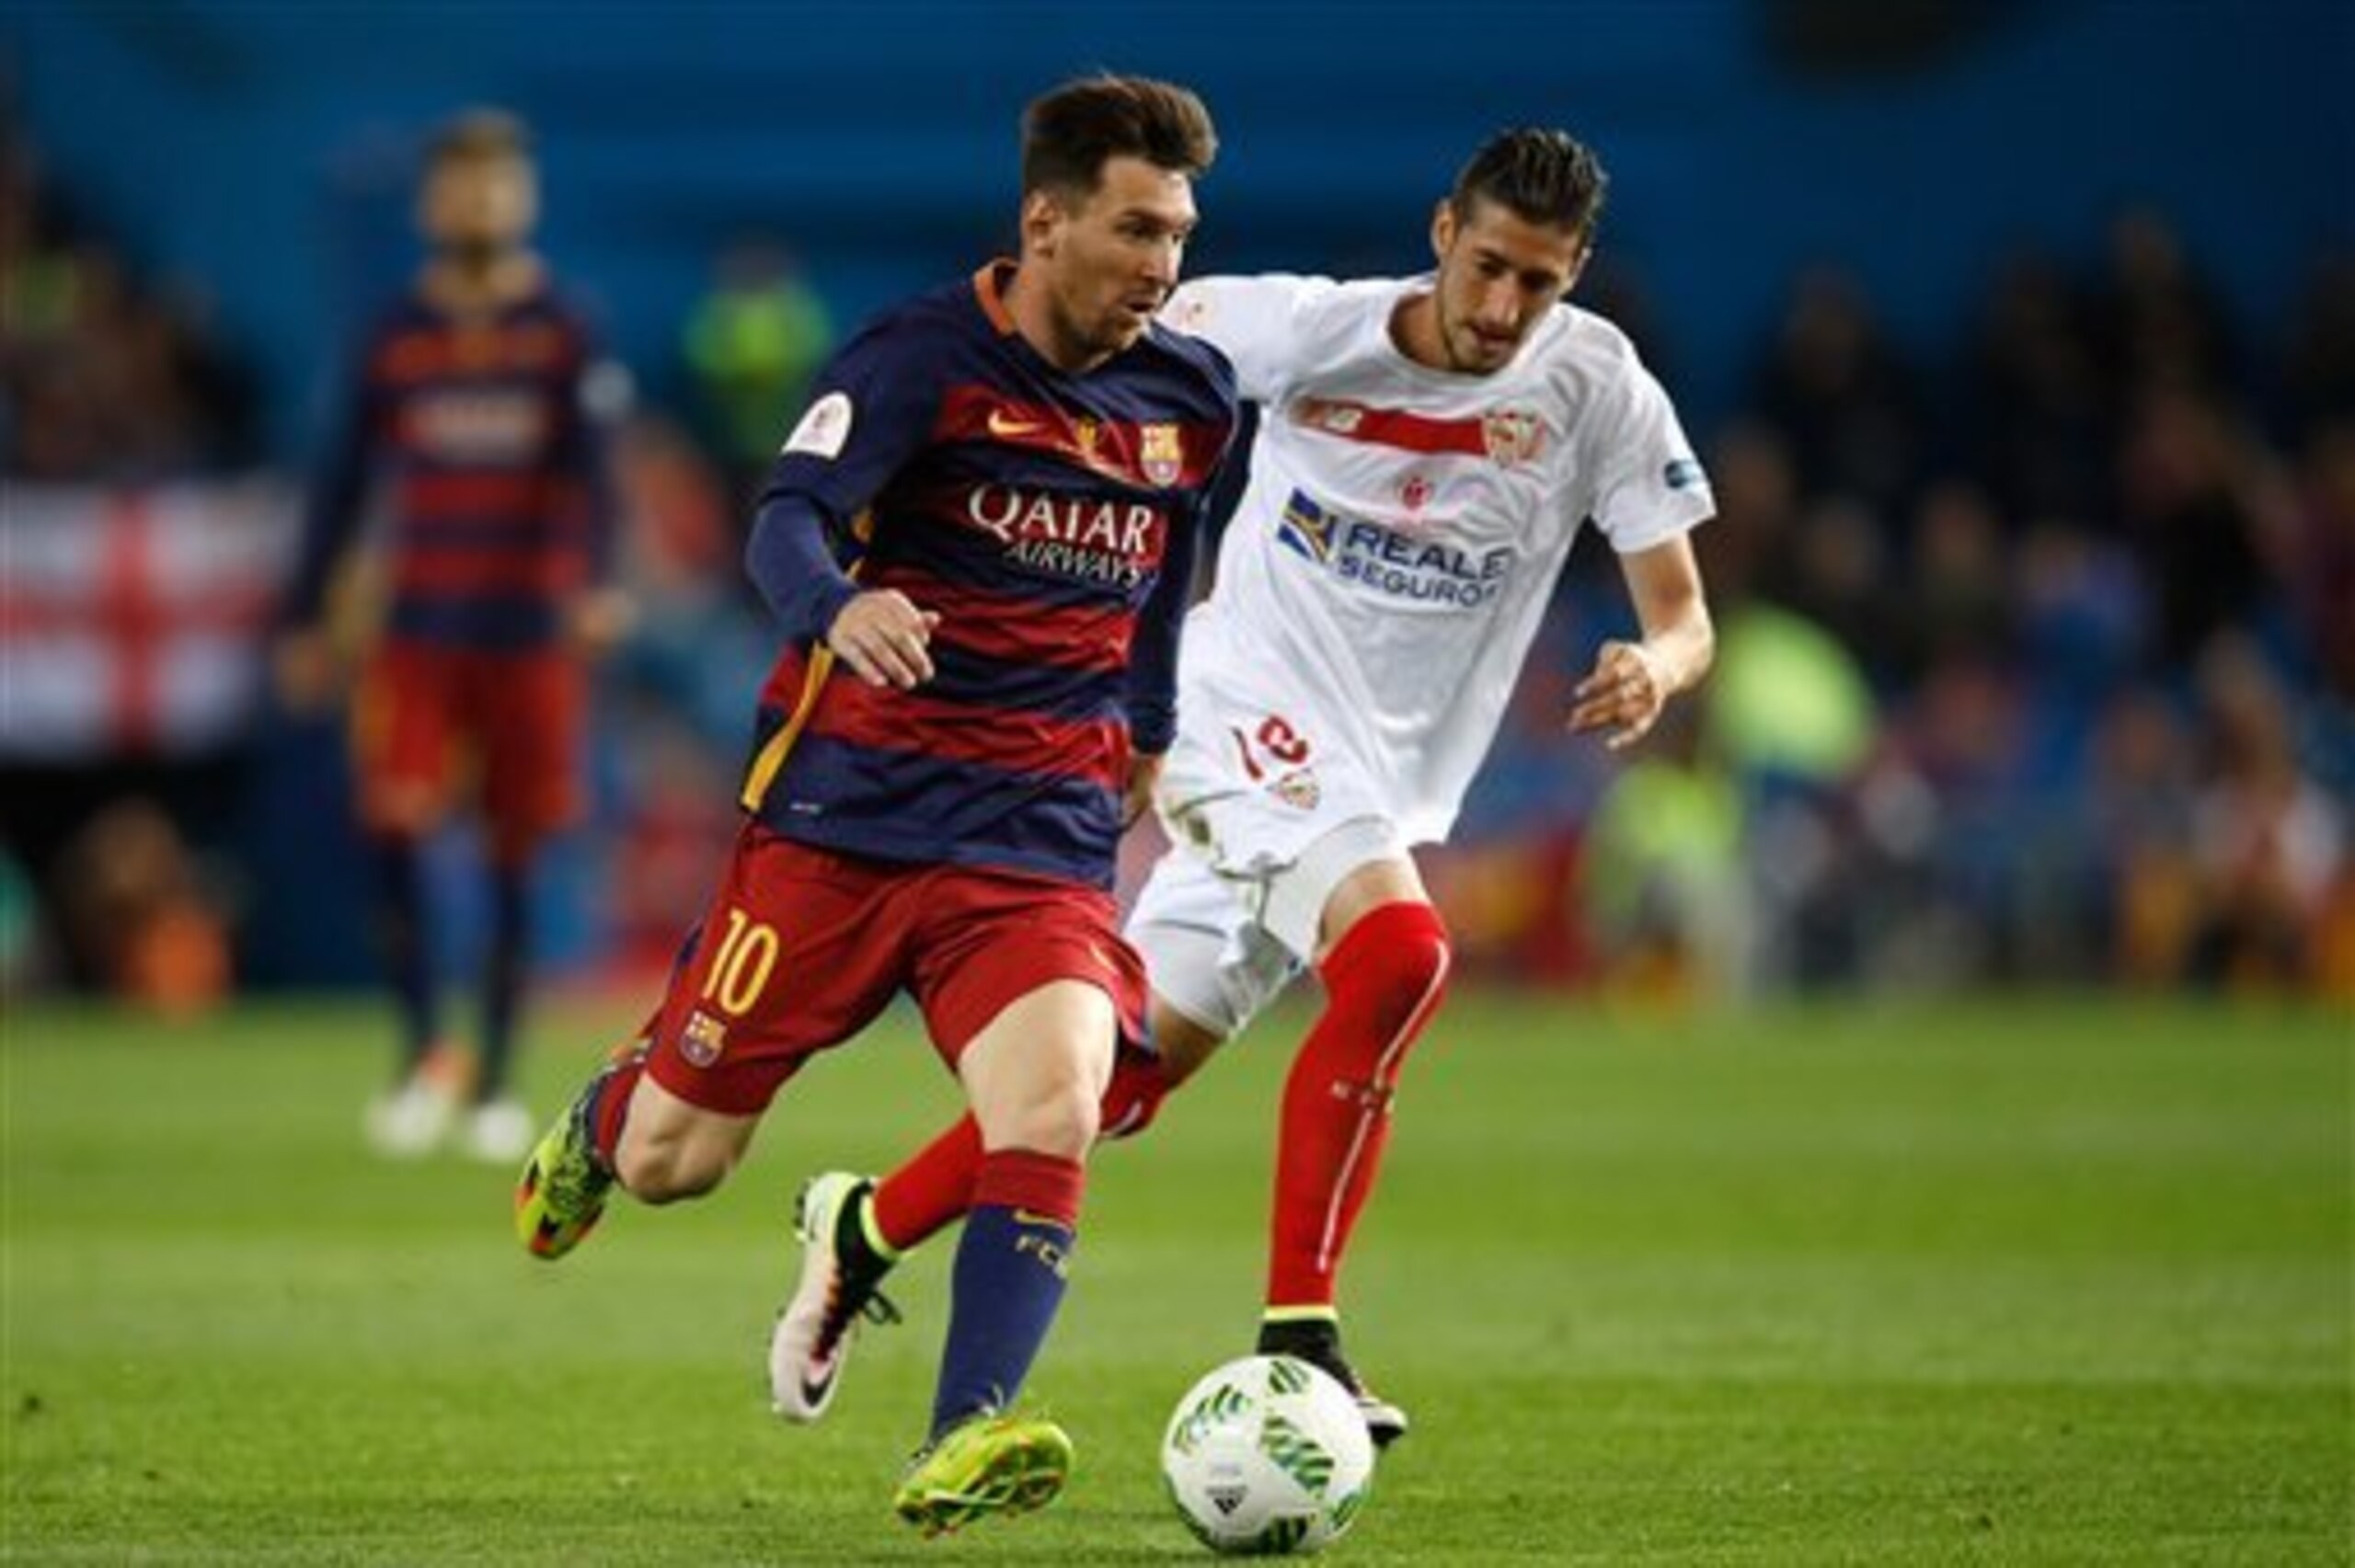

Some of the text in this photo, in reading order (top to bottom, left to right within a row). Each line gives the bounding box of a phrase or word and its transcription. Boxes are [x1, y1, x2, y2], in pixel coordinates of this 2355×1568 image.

[1005, 538, 1142, 588] AIRWAYS
[1345, 524, 1511, 580] REALE
[703, 909, 778, 1016] 10
